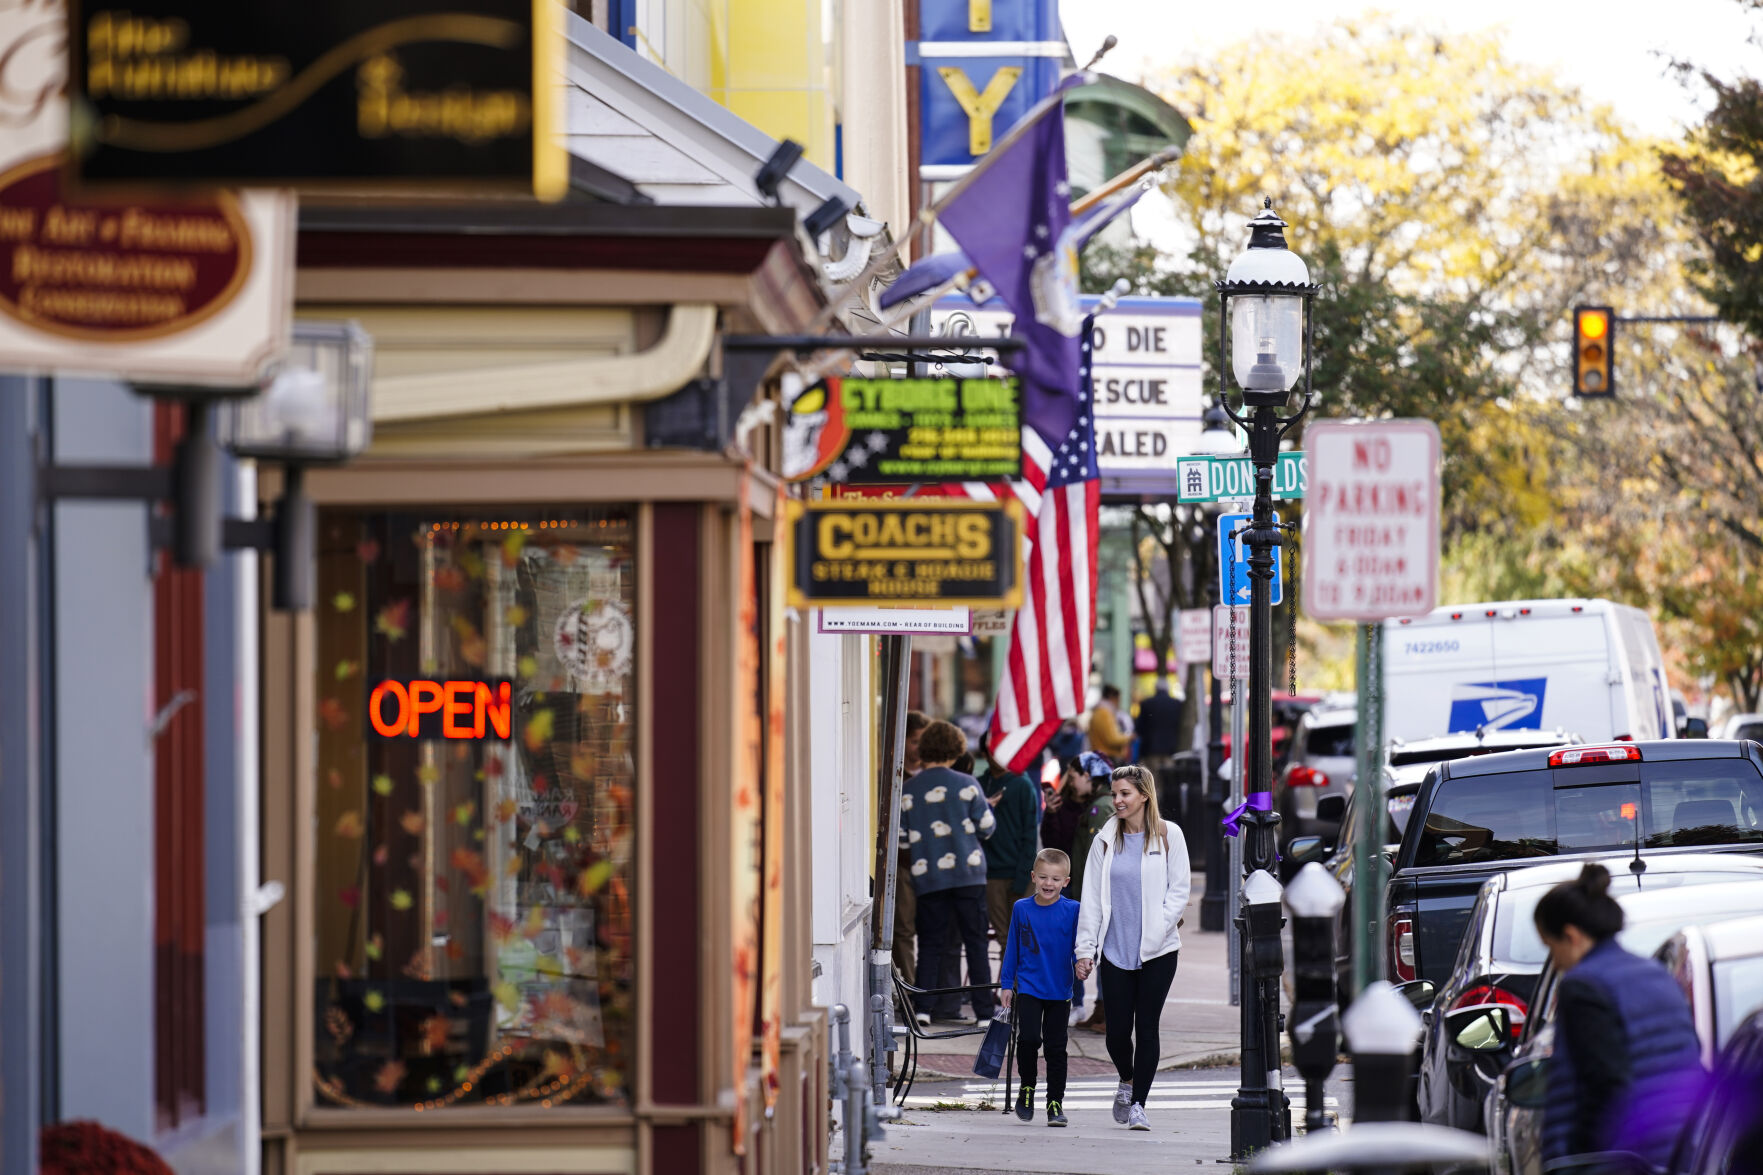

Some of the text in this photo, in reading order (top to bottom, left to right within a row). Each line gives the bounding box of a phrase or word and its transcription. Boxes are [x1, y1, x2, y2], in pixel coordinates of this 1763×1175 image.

[1126, 326, 1167, 352] DIE
[1092, 379, 1168, 404] ESCUE
[1096, 431, 1167, 456] ALED
[1354, 438, 1391, 473] NO
[1211, 458, 1308, 495] DONLDS
[1318, 482, 1424, 516] PARKING
[818, 513, 992, 560] COACHS
[1336, 525, 1405, 546] FRIDAY
[812, 561, 888, 581] STEAK
[973, 621, 1006, 630] FFLES
[1405, 640, 1460, 655] 7422650
[369, 680, 511, 739] OPEN
